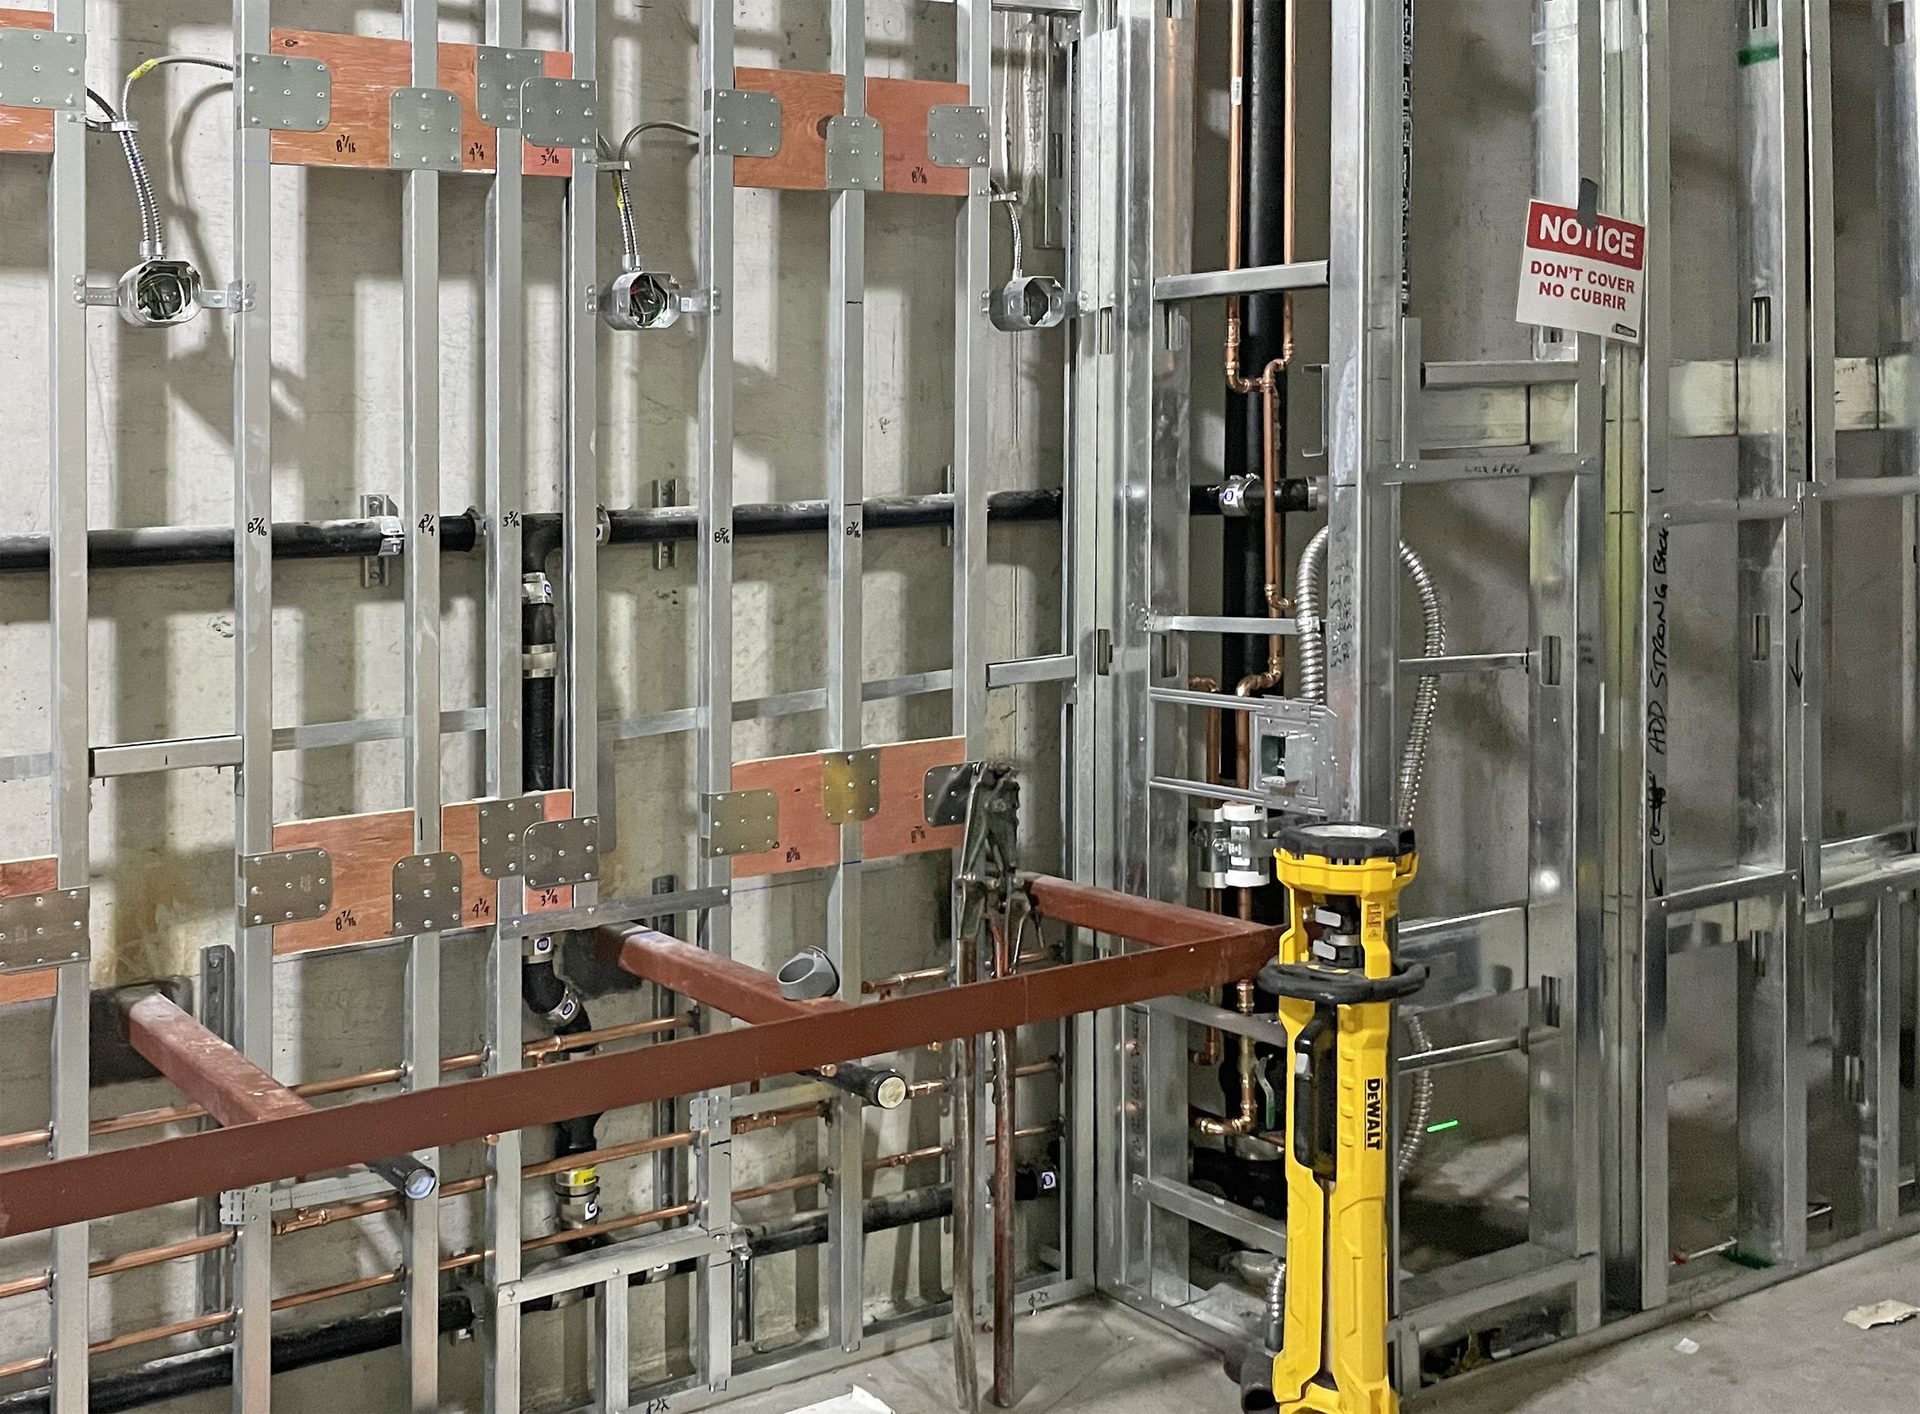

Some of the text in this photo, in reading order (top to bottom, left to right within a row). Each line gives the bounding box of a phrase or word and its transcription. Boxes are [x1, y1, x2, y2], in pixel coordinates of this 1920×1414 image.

[1530, 260, 1635, 294] DON'T COVER
[1539, 281, 1626, 311] NO CUBRIR
[1650, 584, 1668, 688] STRONG
[1648, 700, 1667, 755] ADD
